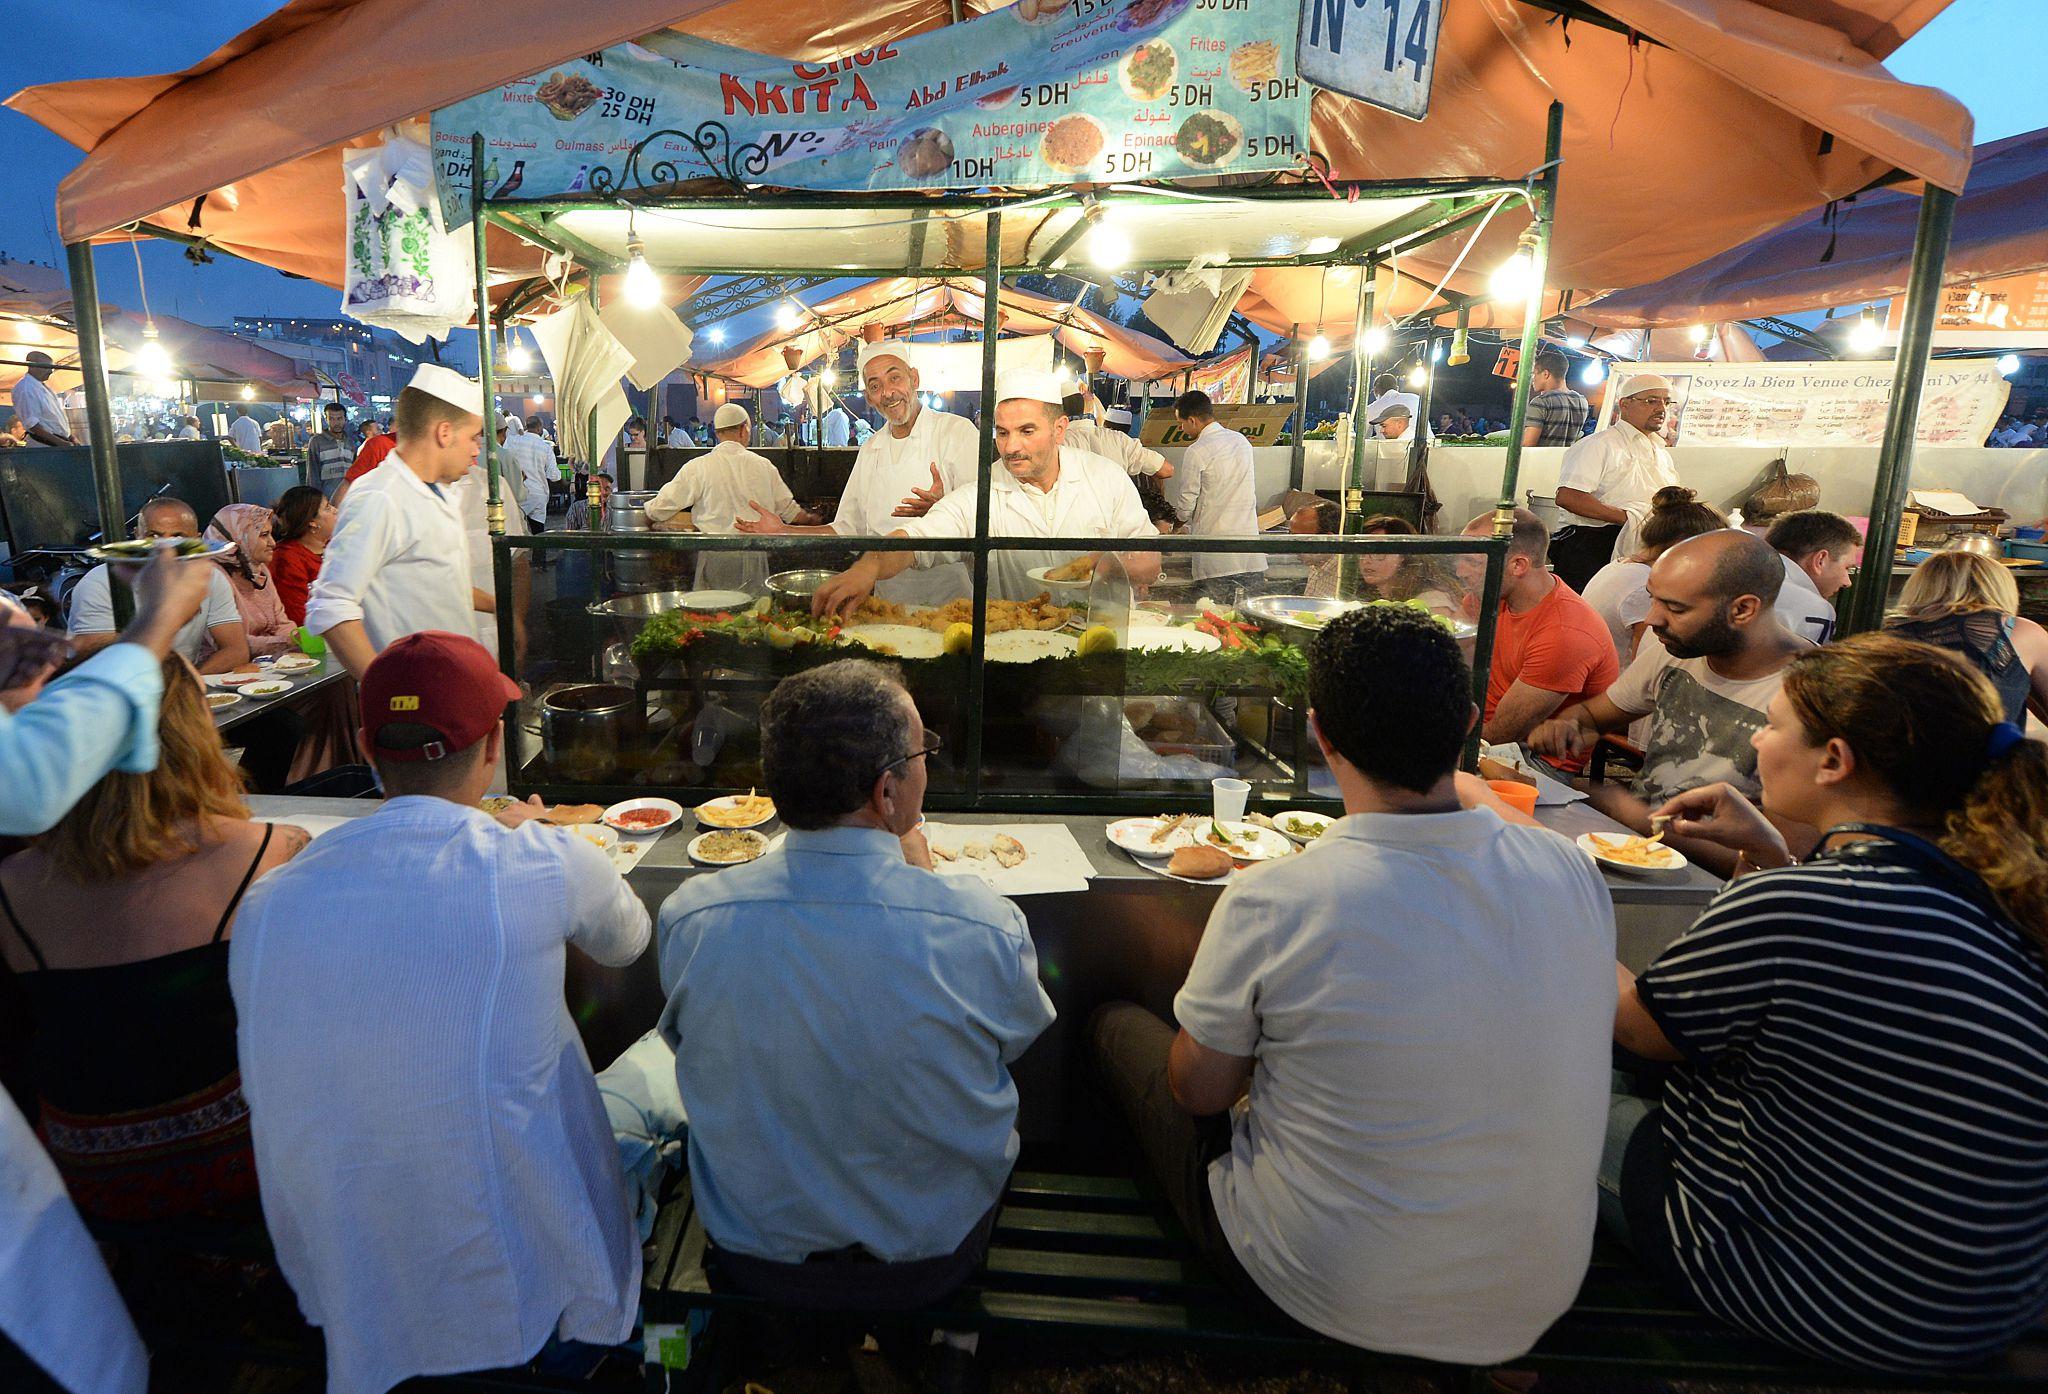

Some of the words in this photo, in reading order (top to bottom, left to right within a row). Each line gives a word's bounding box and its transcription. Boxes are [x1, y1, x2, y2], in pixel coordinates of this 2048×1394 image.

[1190, 36, 1226, 52] Frites
[1384, 0, 1430, 82] 14
[905, 79, 947, 110] Abd
[955, 61, 1010, 93] Elhak
[1071, 69, 1110, 90] فلفل
[1250, 82, 1261, 102] 5
[1268, 78, 1299, 100] DH
[503, 91, 533, 103] Mixte
[604, 87, 626, 103] 30
[629, 96, 655, 112] DH
[1020, 87, 1032, 107] 5
[1038, 82, 1069, 106] DH
[1169, 85, 1179, 106] 5
[1184, 84, 1213, 106] DH
[601, 102, 621, 117] 25
[625, 108, 652, 126] DH
[972, 120, 1055, 138] Aubergines
[555, 139, 605, 151] Oulmass
[664, 141, 688, 152] Eau
[869, 138, 898, 153] Pain
[1124, 132, 1178, 151] Epinard
[1247, 138, 1259, 157] 5
[1265, 135, 1295, 156] DH
[447, 162, 473, 178] DH
[1105, 154, 1116, 173] 5
[1122, 152, 1152, 173] DH
[1695, 375, 1739, 390] Soyez
[1743, 376, 1756, 387] la
[1760, 376, 1795, 387] Bien
[1802, 376, 1848, 387] Venue
[1853, 376, 1892, 387] Chez
[1946, 374, 1970, 385] N°
